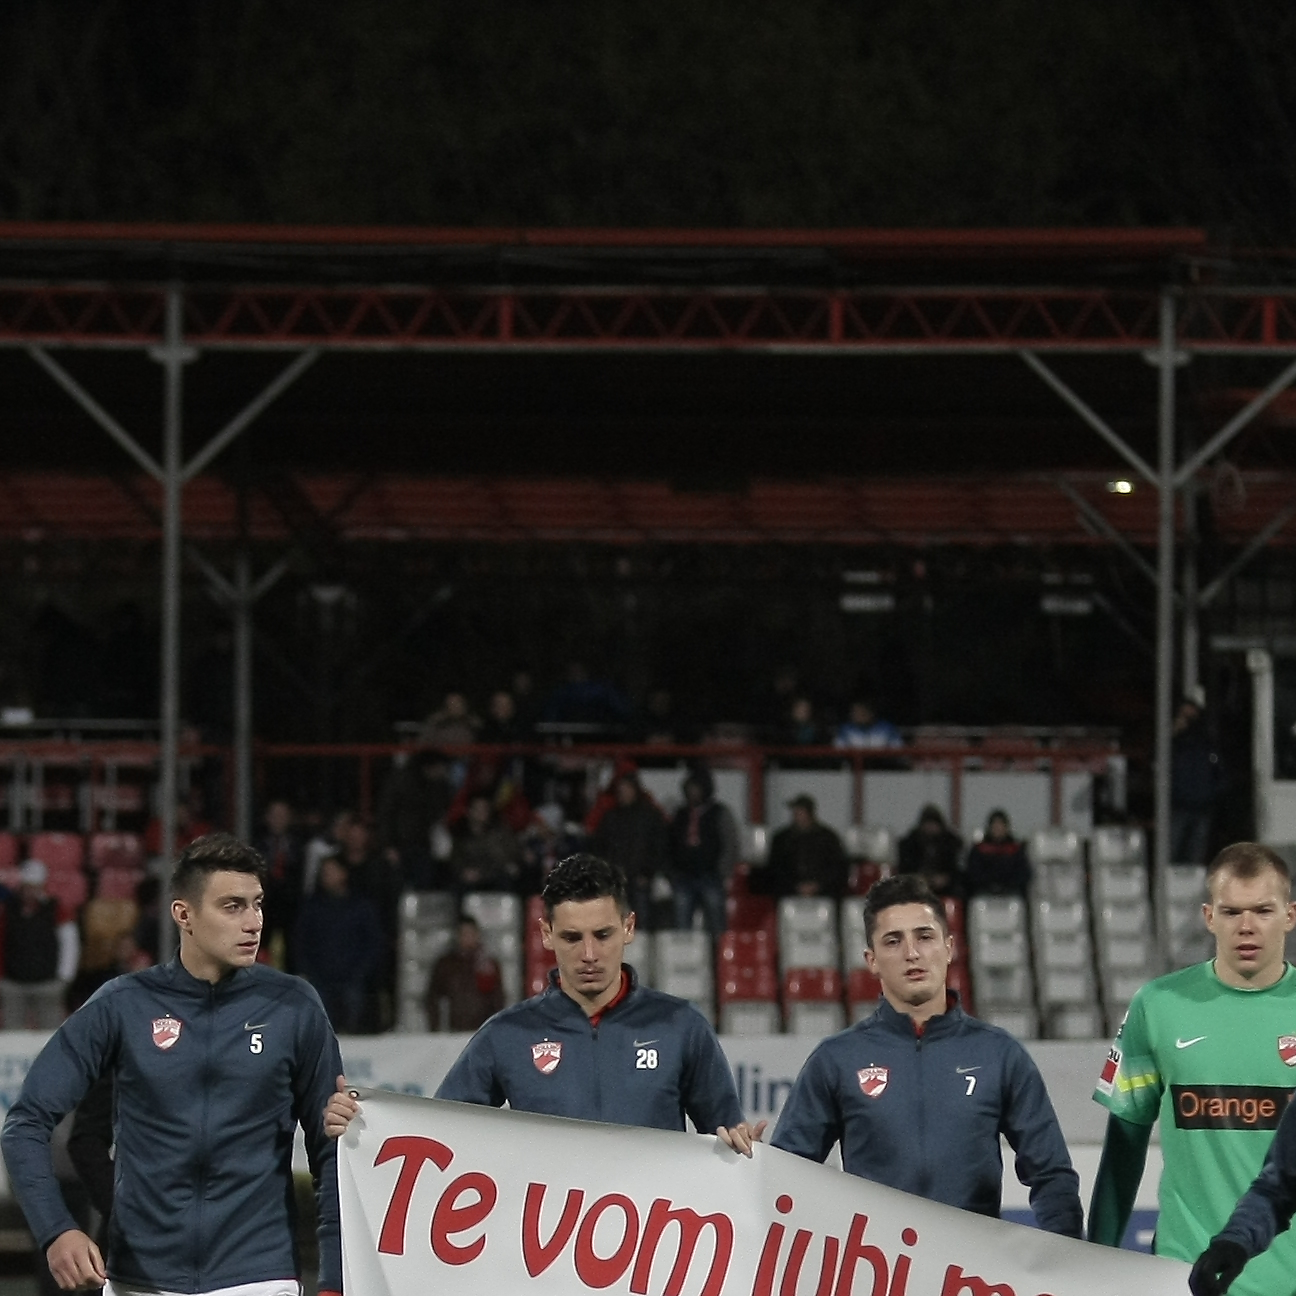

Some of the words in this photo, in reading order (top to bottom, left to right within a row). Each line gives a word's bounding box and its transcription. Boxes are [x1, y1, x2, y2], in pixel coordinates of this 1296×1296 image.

[249, 1033, 263, 1054] 5
[636, 1048, 658, 1069] 28
[965, 1075, 976, 1096] 7
[1180, 1091, 1276, 1123] Orange
[375, 1135, 498, 1266] Te
